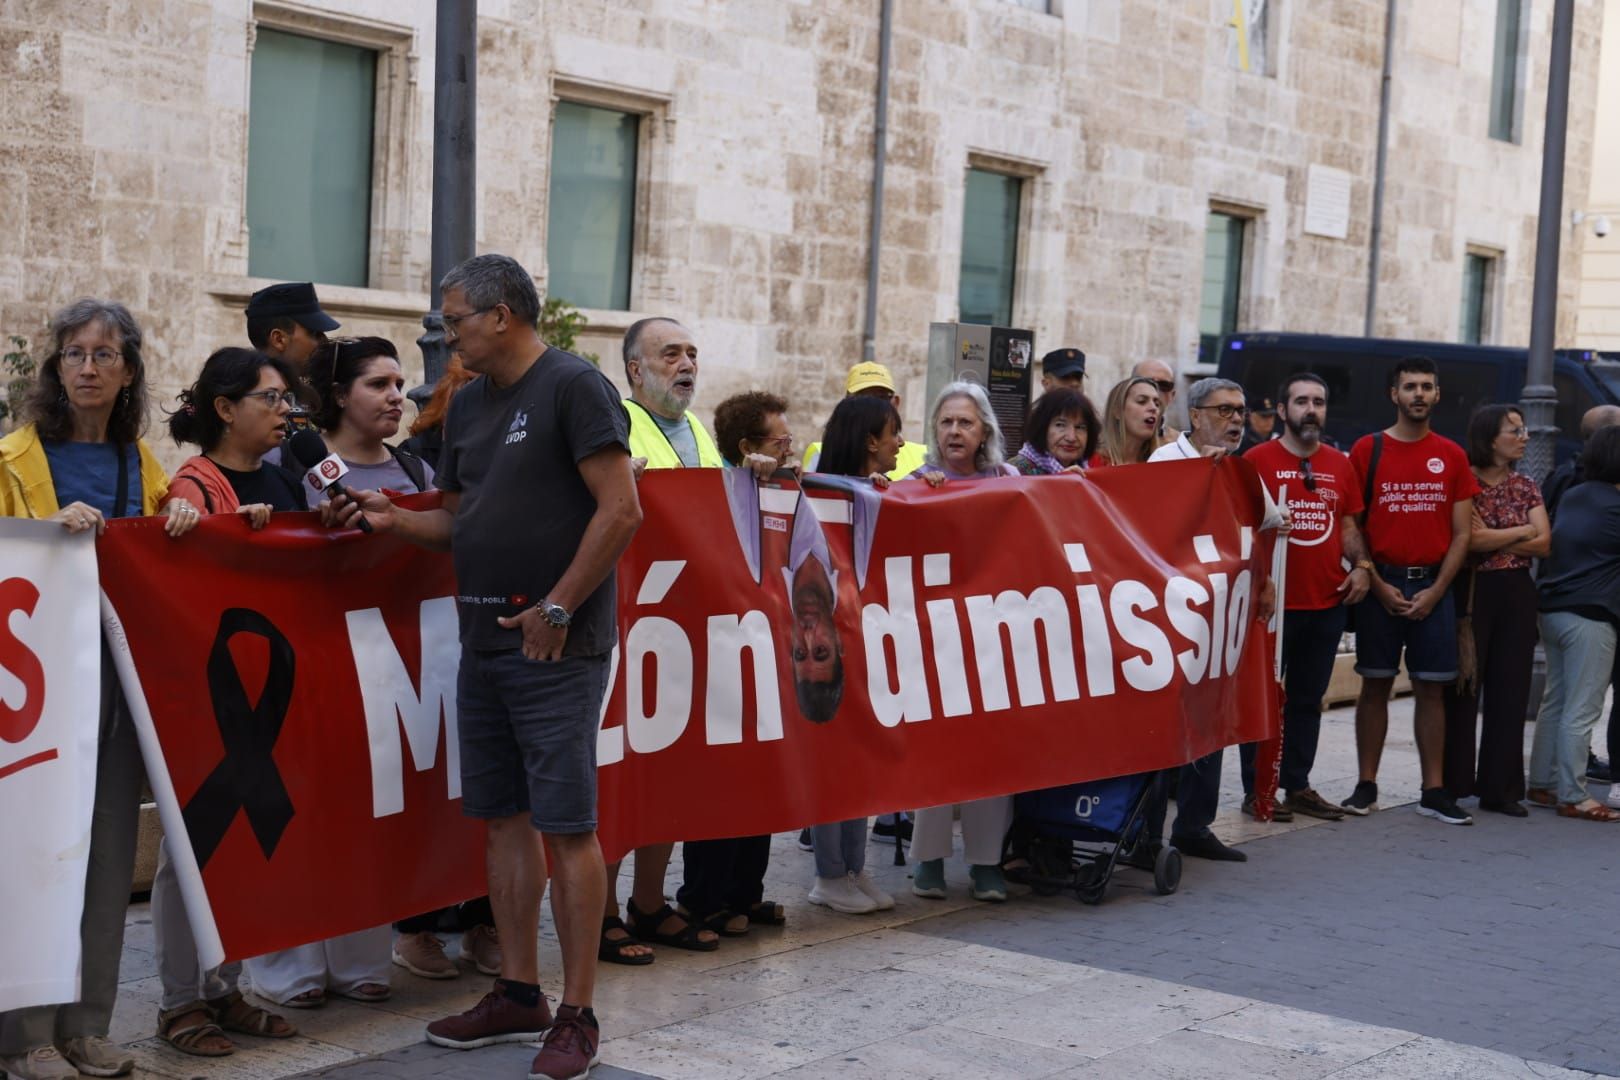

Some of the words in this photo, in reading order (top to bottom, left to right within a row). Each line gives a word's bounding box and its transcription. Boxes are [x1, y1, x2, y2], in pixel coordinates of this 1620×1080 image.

[1276, 470, 1297, 479] UGT
[1381, 482, 1391, 492] Sí
[1414, 481, 1444, 490] servei
[1379, 492, 1406, 505] públic
[1407, 492, 1447, 502] educatiu
[1288, 500, 1325, 509] Salvem
[1388, 503, 1400, 512] de
[1402, 503, 1436, 515] qualitat
[861, 526, 1253, 727] dimissió
